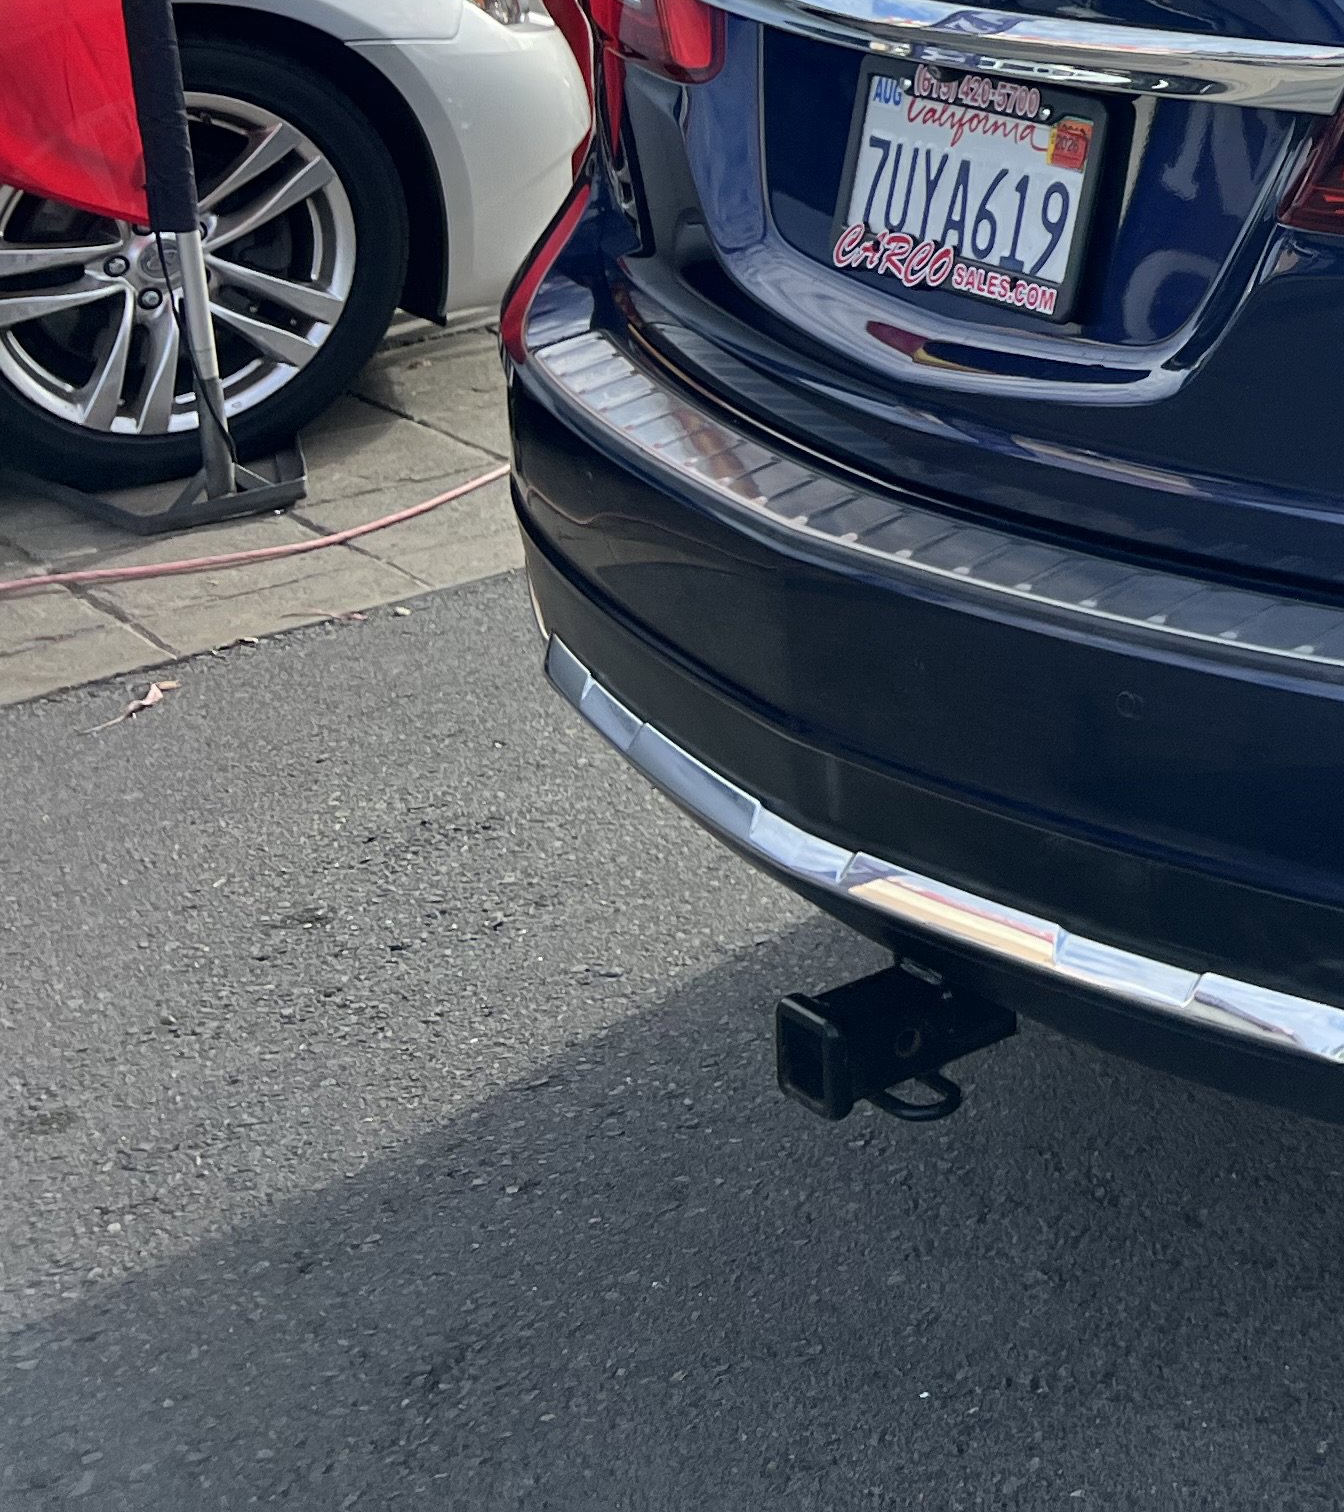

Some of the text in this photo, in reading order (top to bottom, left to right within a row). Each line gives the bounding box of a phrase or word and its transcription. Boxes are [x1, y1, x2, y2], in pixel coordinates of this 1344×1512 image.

[872, 77, 903, 106] AUG
[957, 73, 1041, 118] 420-5700
[907, 97, 1048, 148] California
[862, 134, 1070, 276] 7UYA619
[833, 223, 1058, 316] CARCO SALES.COM
